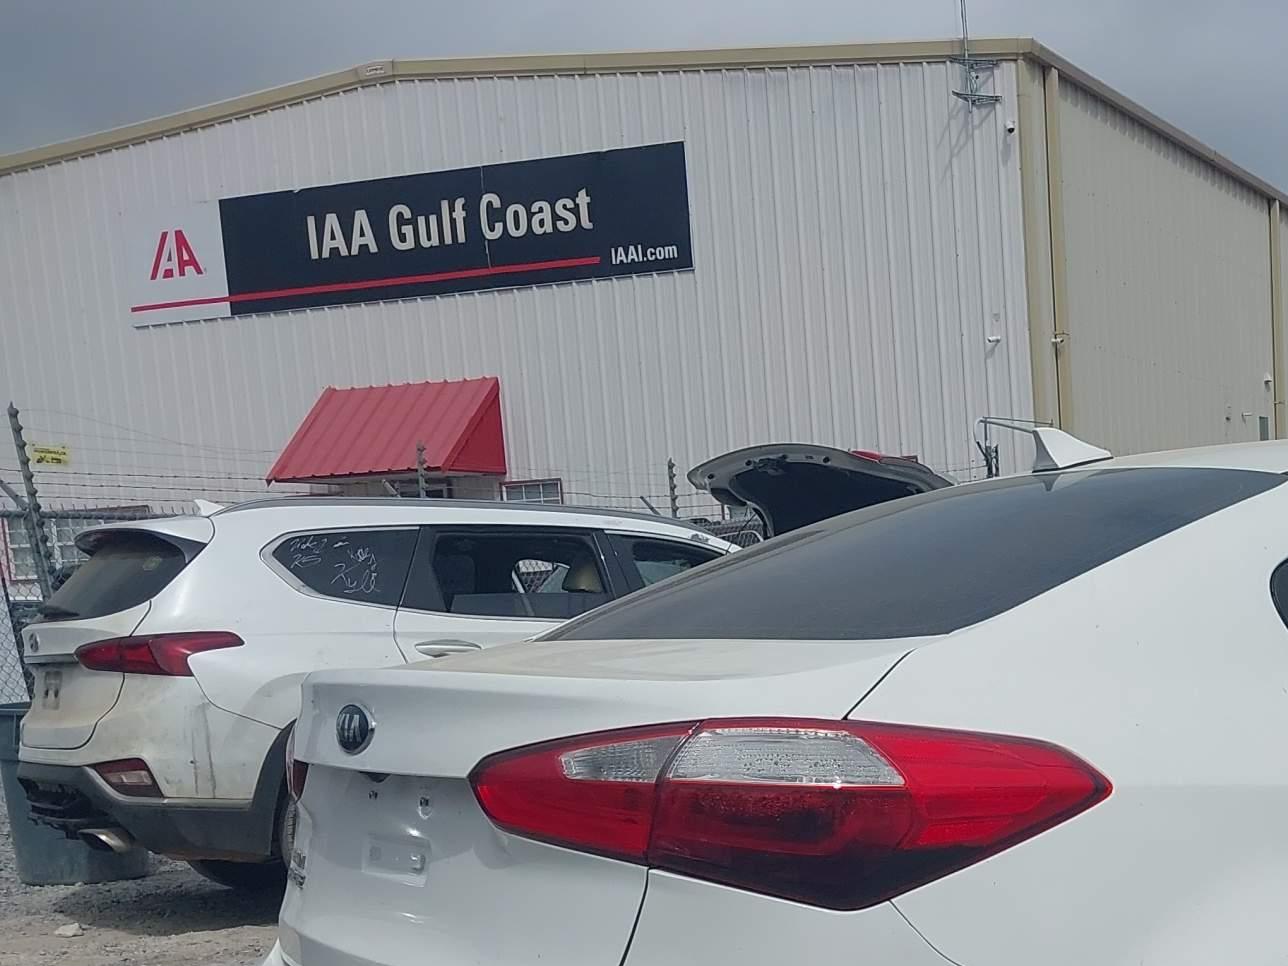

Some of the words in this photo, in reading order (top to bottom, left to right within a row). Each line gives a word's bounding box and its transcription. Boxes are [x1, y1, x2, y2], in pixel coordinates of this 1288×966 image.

[307, 209, 378, 260] IAA
[389, 197, 466, 251] Gulf
[480, 188, 593, 242] Coast
[611, 244, 678, 266] IAAI.com
